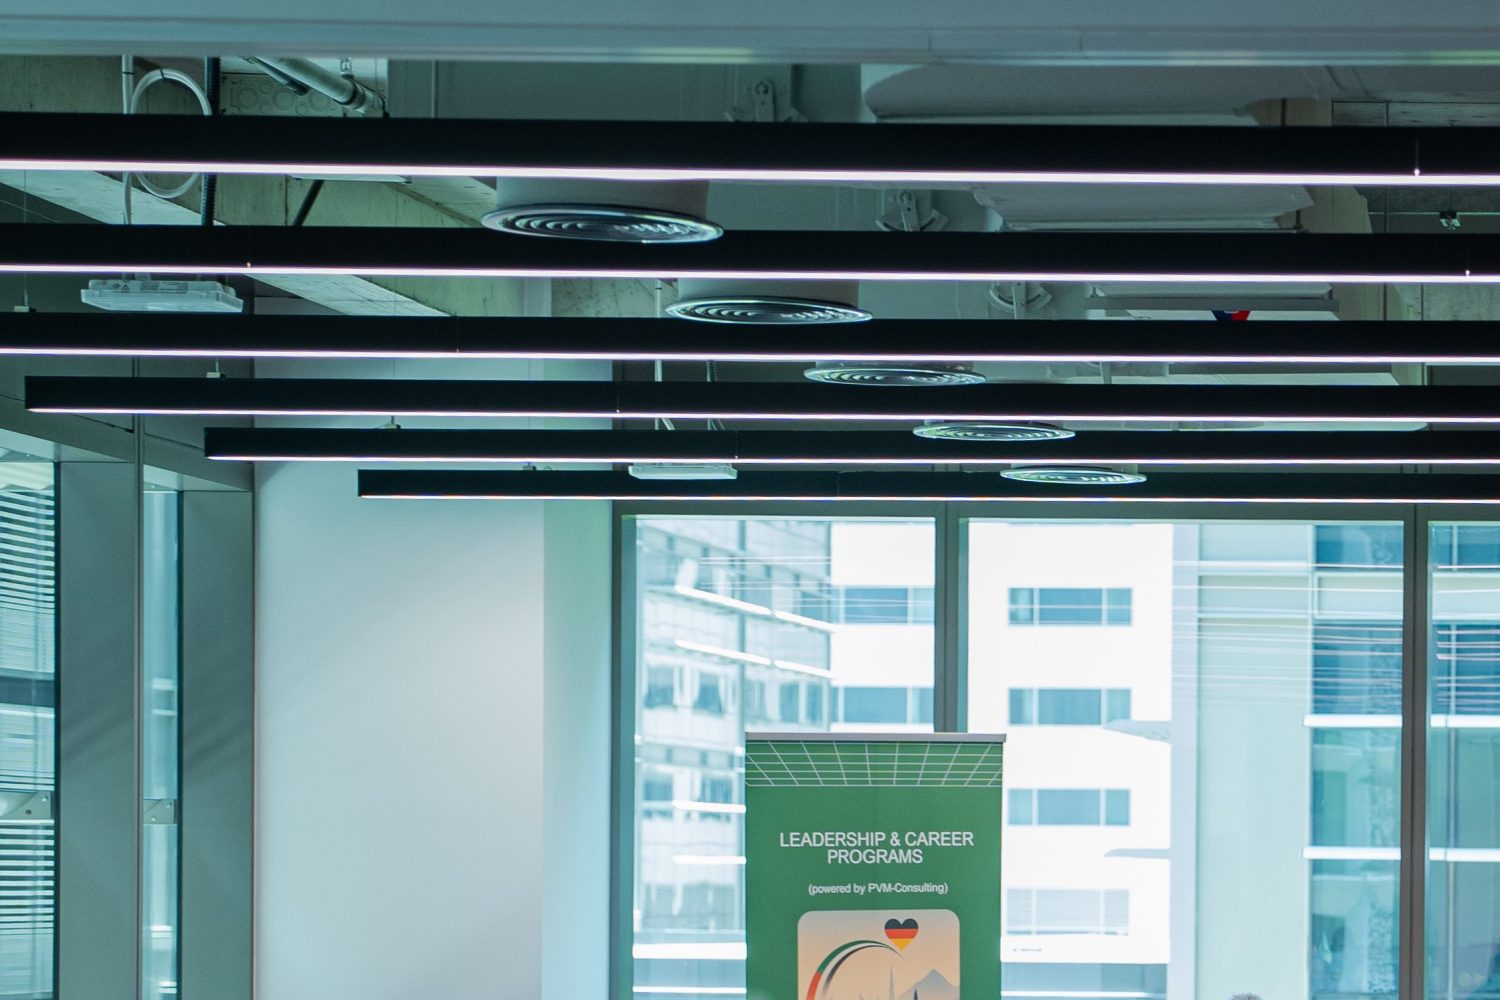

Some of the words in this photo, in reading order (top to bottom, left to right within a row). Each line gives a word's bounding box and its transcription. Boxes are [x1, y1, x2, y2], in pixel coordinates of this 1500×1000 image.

[779, 832, 886, 847] LEADERSHIP
[890, 832, 900, 846] &
[904, 832, 974, 846] CAREER
[827, 849, 923, 864] PROGRAMS
[808, 884, 851, 896] (powered
[853, 884, 865, 895] by
[868, 883, 948, 895] PVM-Consulting)
